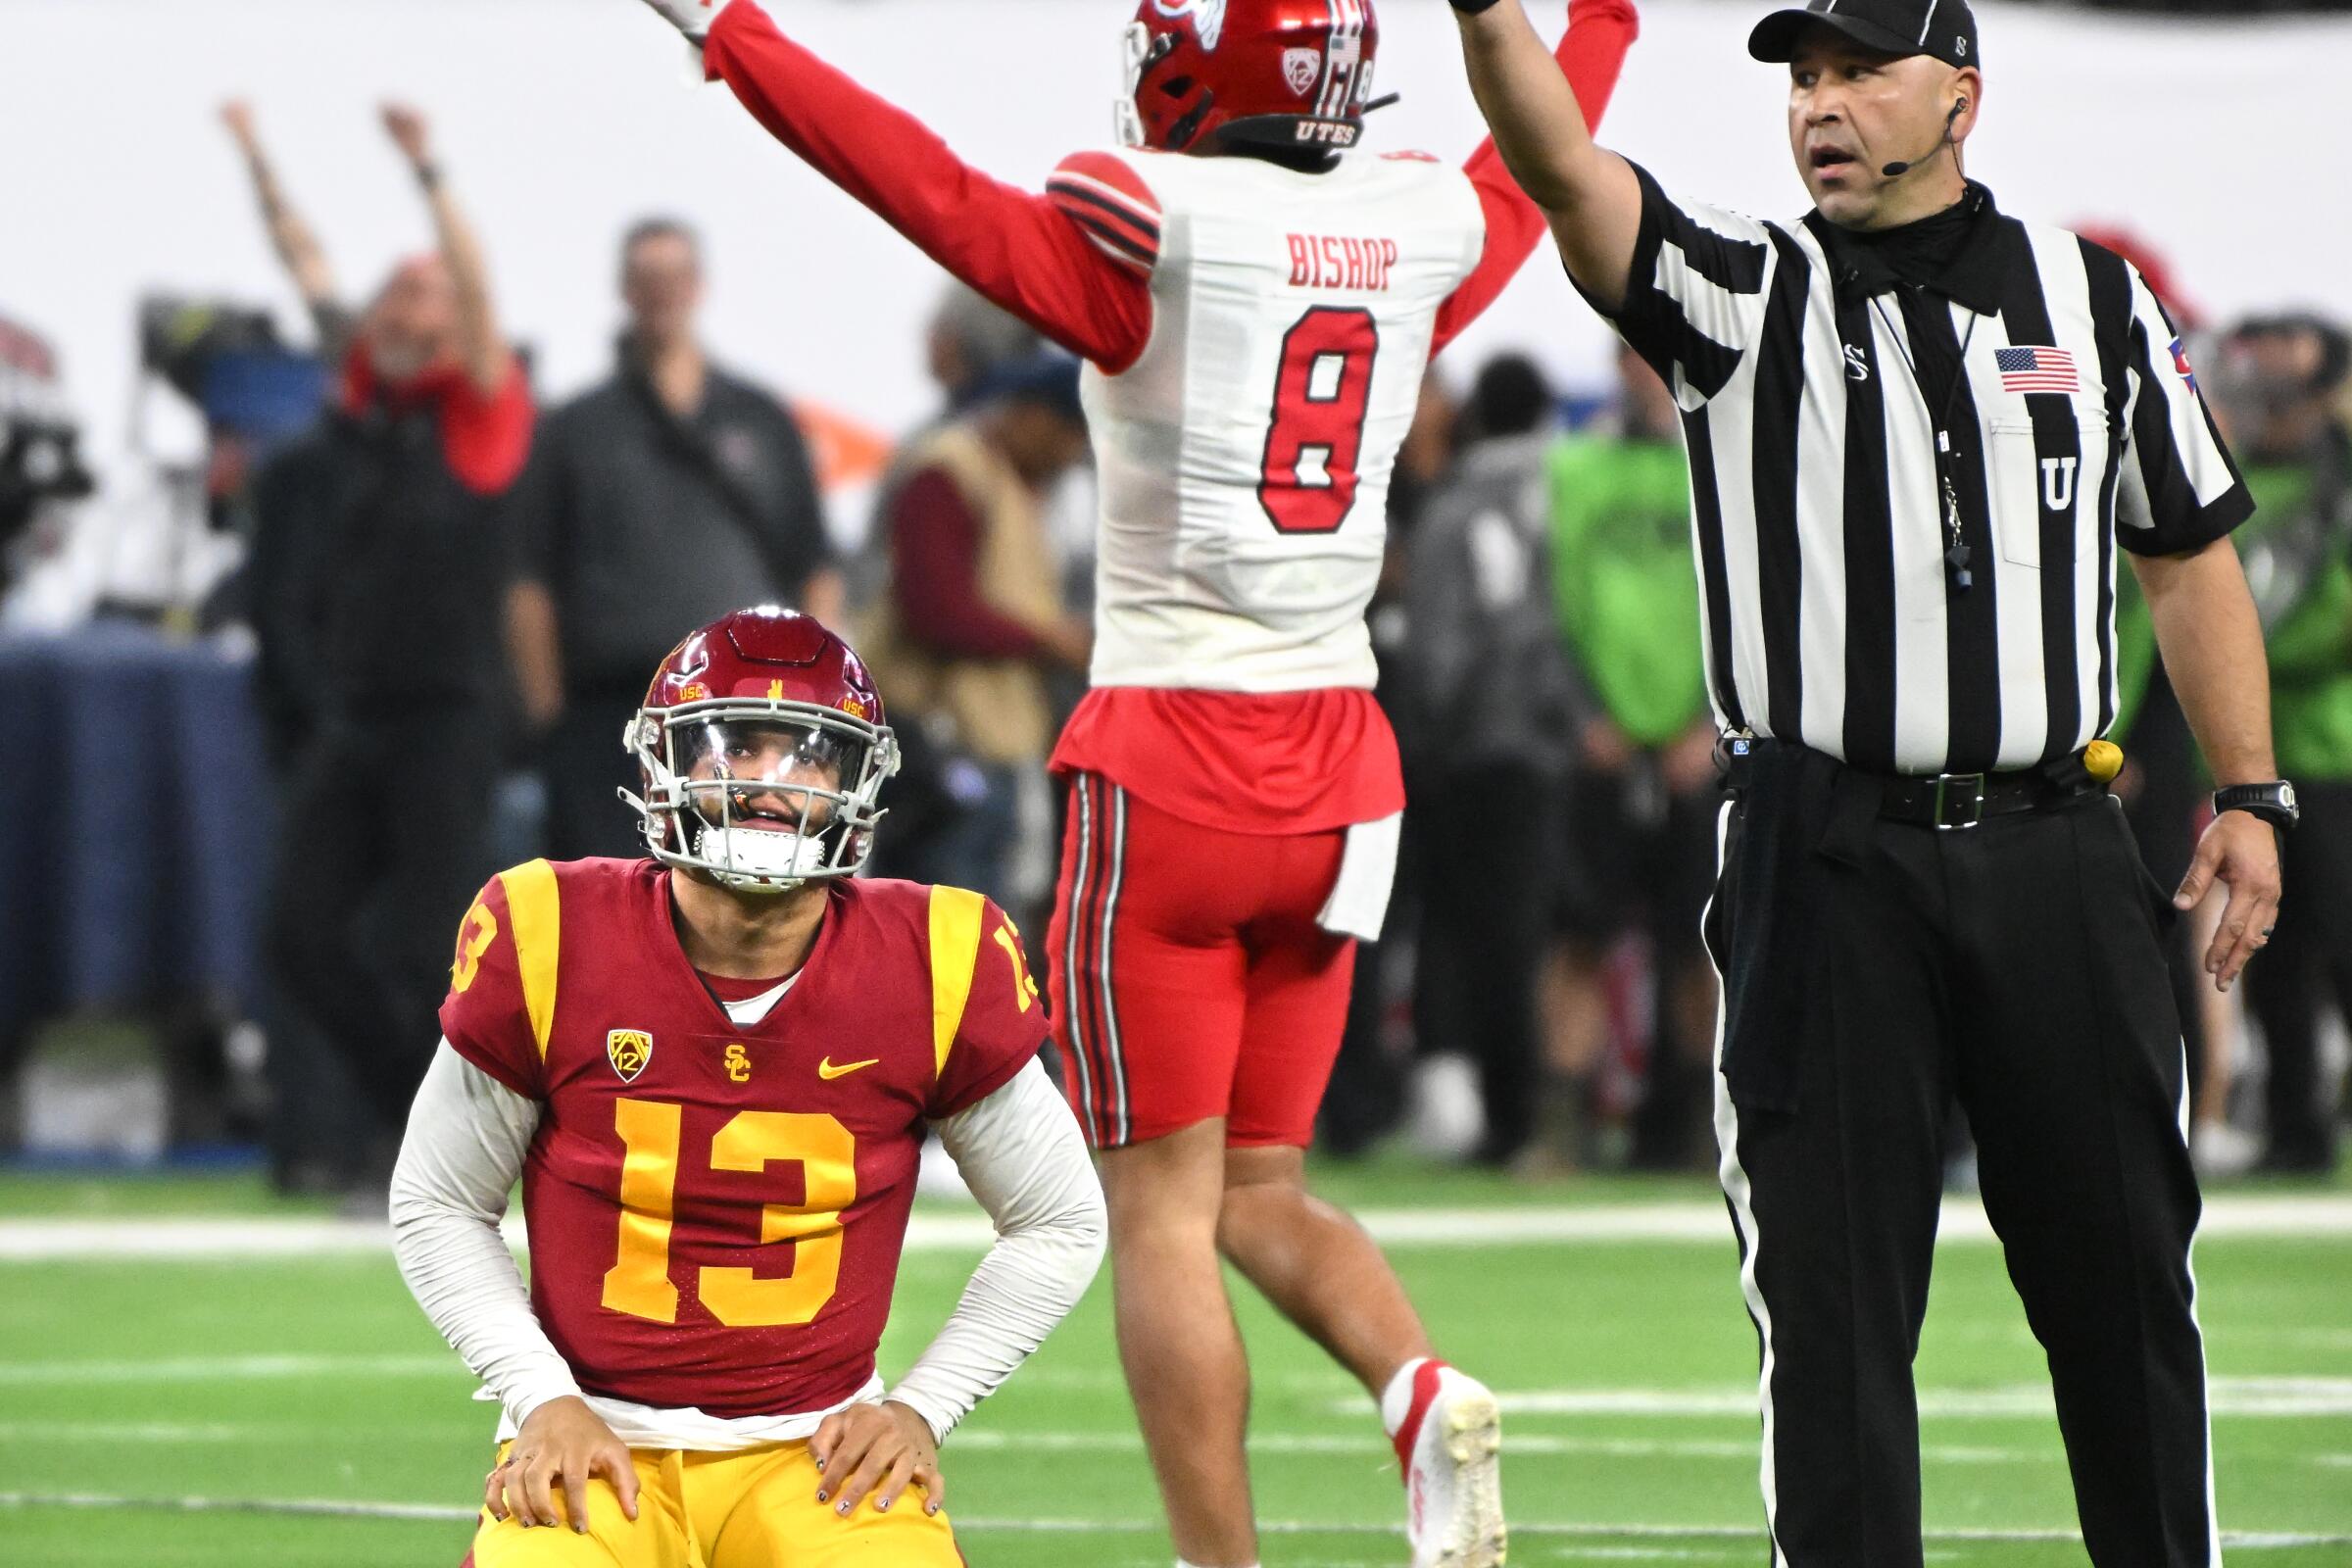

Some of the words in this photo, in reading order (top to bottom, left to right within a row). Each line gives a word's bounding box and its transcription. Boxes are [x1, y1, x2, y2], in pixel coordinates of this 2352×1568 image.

[1296, 121, 1355, 144] UTES
[1286, 233, 1398, 292] BISHOP
[1256, 304, 1380, 534] 8
[2041, 457, 2077, 511] U
[679, 686, 704, 701] USC
[843, 698, 864, 718] USC
[610, 1032, 651, 1063] PAC
[617, 1052, 639, 1071] 12
[601, 1097, 857, 1327] 13
